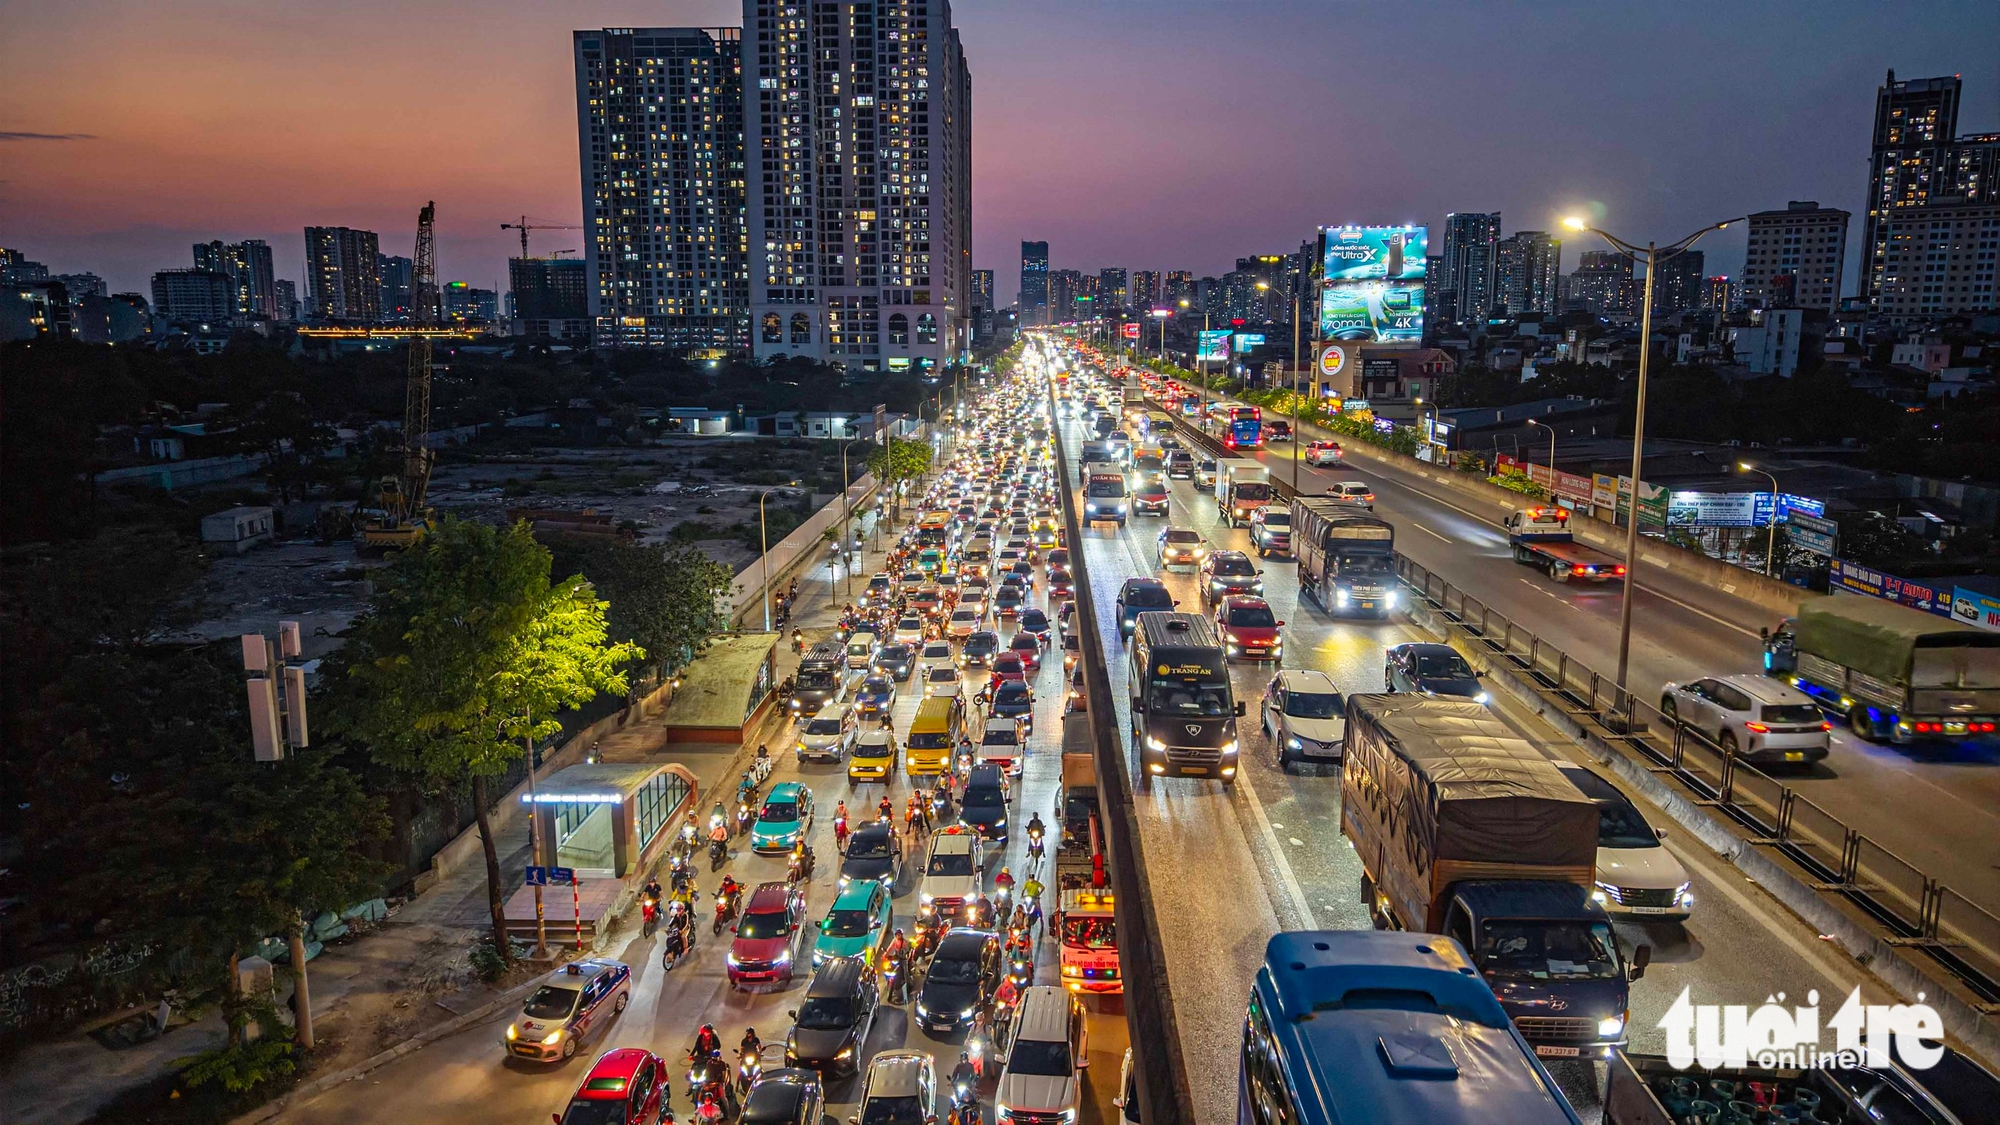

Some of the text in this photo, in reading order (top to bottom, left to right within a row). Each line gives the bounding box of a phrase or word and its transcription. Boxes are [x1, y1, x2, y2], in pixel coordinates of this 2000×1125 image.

[1395, 317, 1412, 329] 4K
[1885, 577, 1901, 592] T-T
[1902, 582, 1932, 601] AUTO
[1938, 593, 1951, 604] 419
